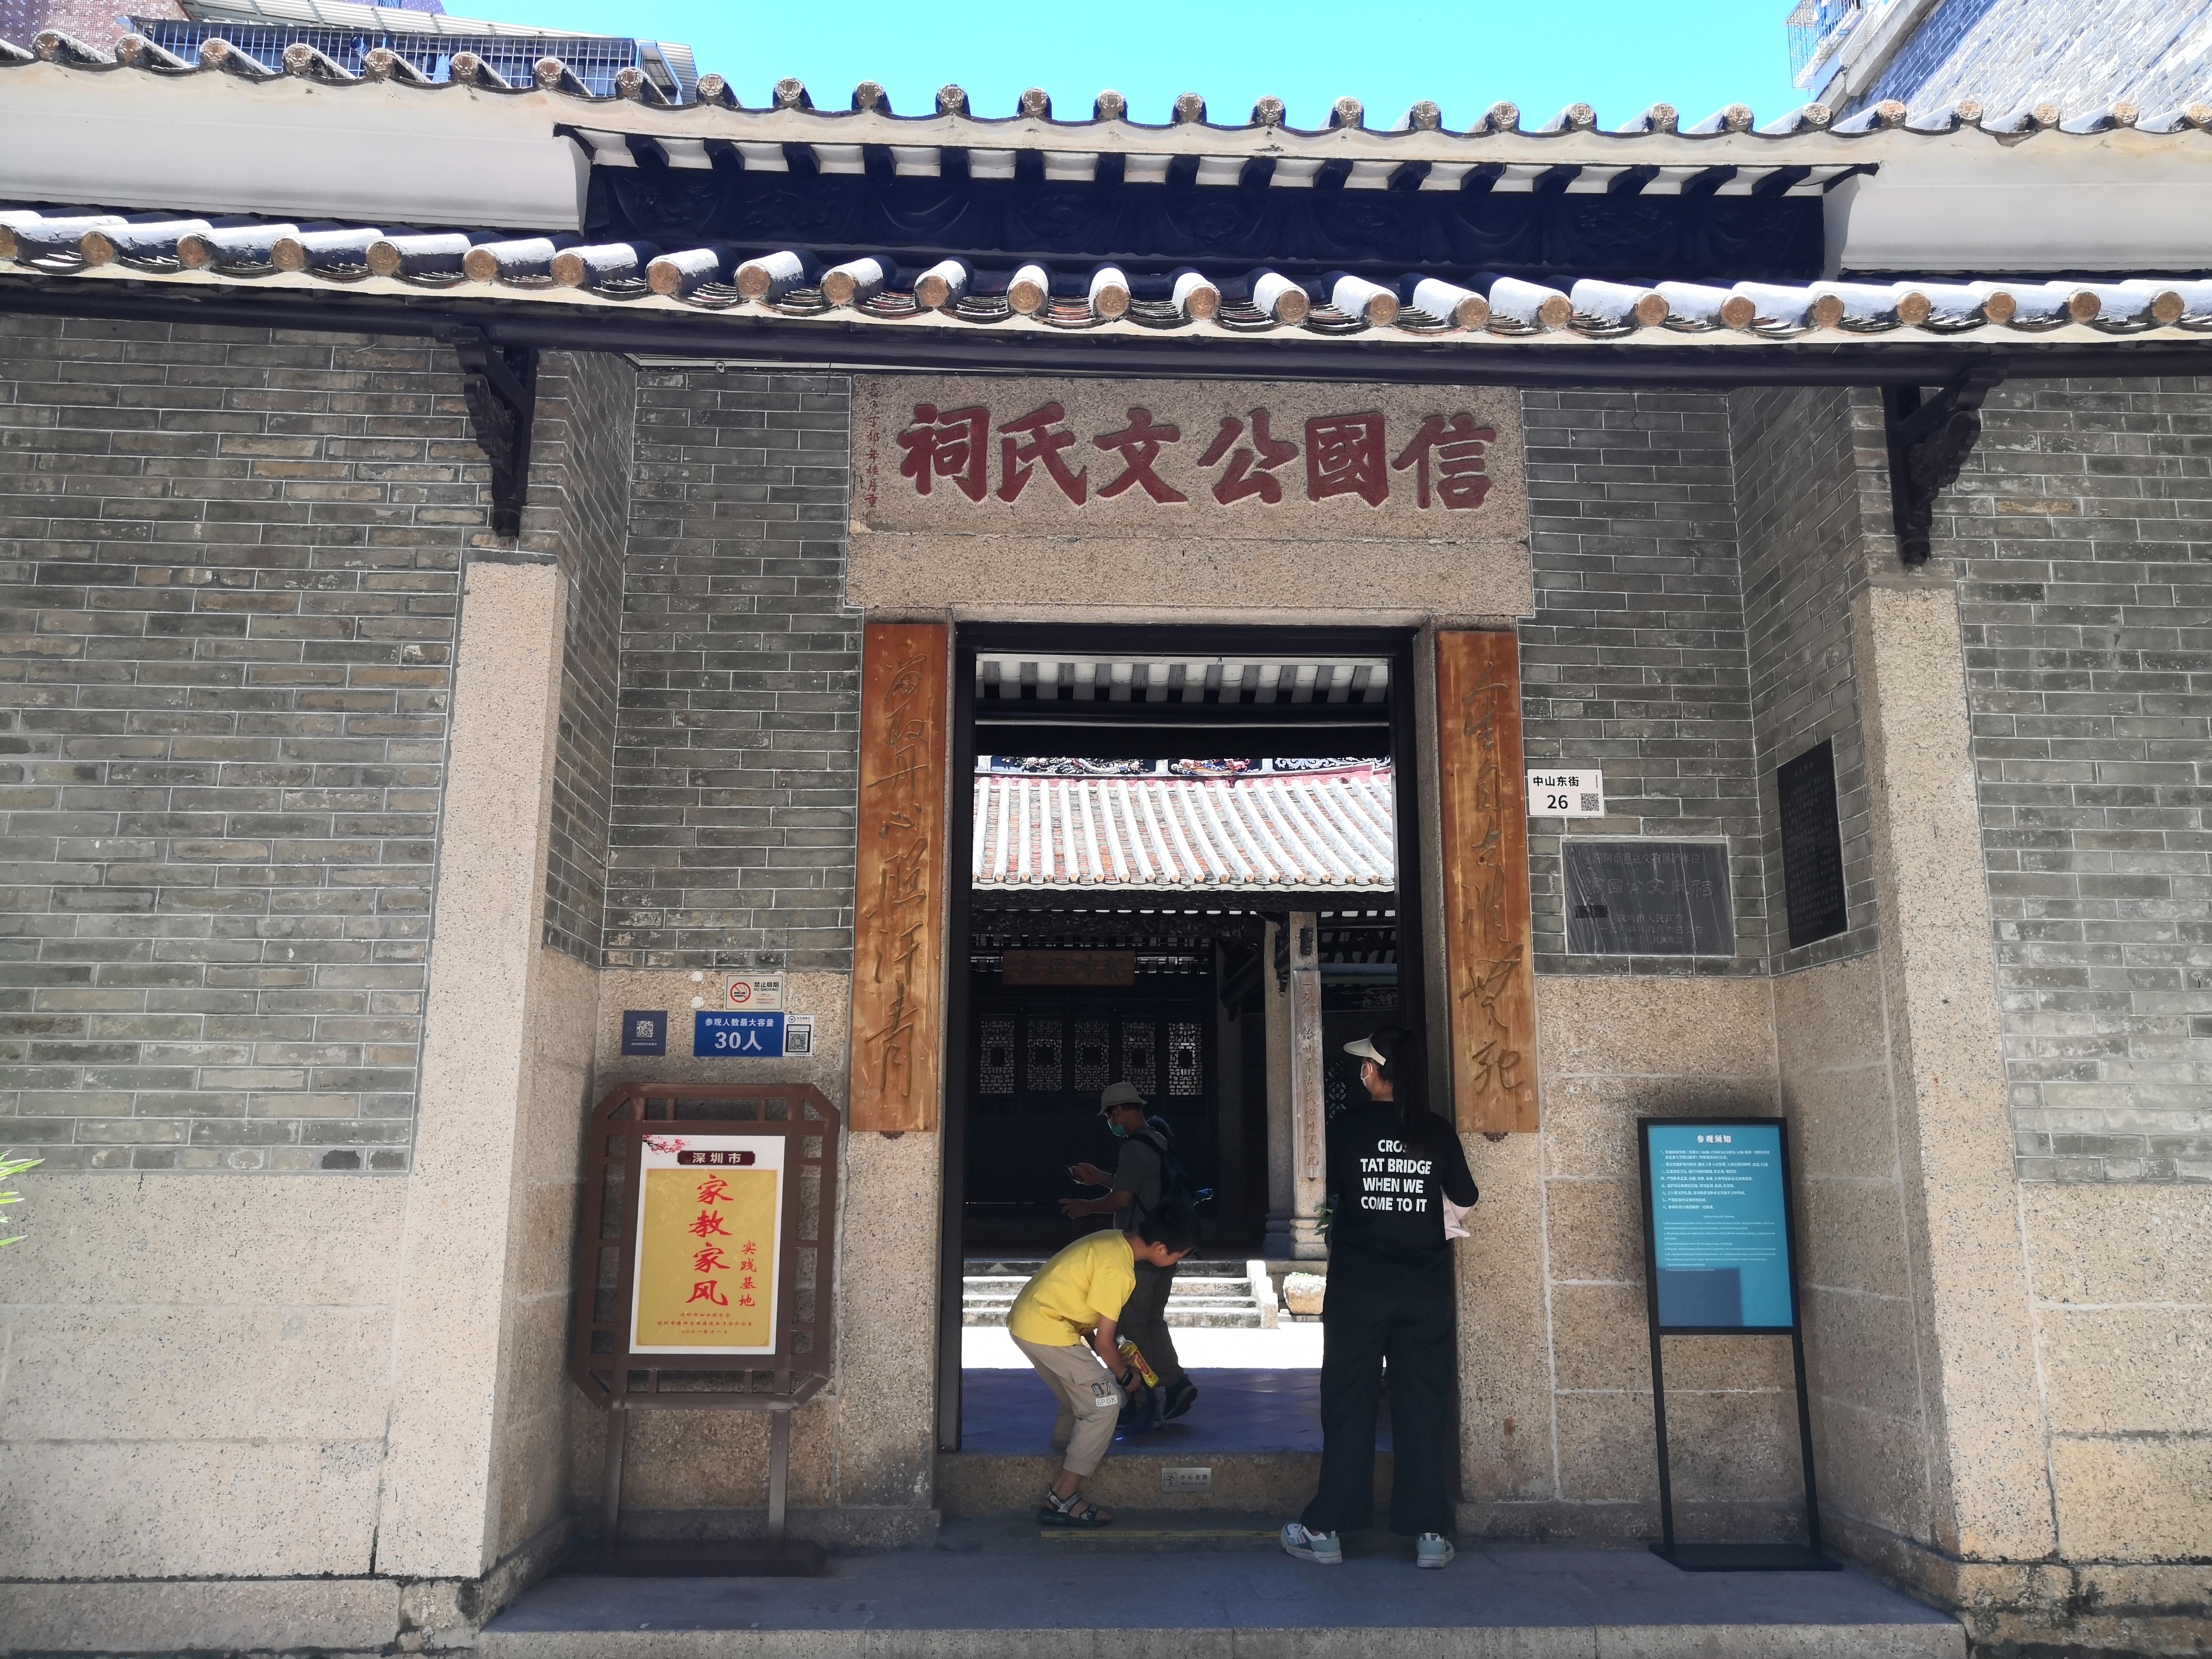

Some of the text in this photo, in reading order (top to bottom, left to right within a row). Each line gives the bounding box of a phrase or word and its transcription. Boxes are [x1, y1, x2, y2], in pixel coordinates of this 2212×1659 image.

[896, 403, 1497, 511] 信國公文氏祠
[1533, 776, 1580, 787] 中山东街
[1546, 794, 1569, 809] 26
[705, 1018, 774, 1028] 参观人数最大容量
[715, 1030, 763, 1051] 30人
[1697, 1134, 1732, 1144] 参观须知
[692, 1152, 742, 1164] 深圳市
[1360, 1158, 1432, 1175] TAT BRIDGE
[1362, 1177, 1424, 1194] WHEN WE
[1361, 1196, 1428, 1212] COME TO IT
[685, 1174, 735, 1306] 家教家风
[738, 1240, 757, 1307] 实践基地
